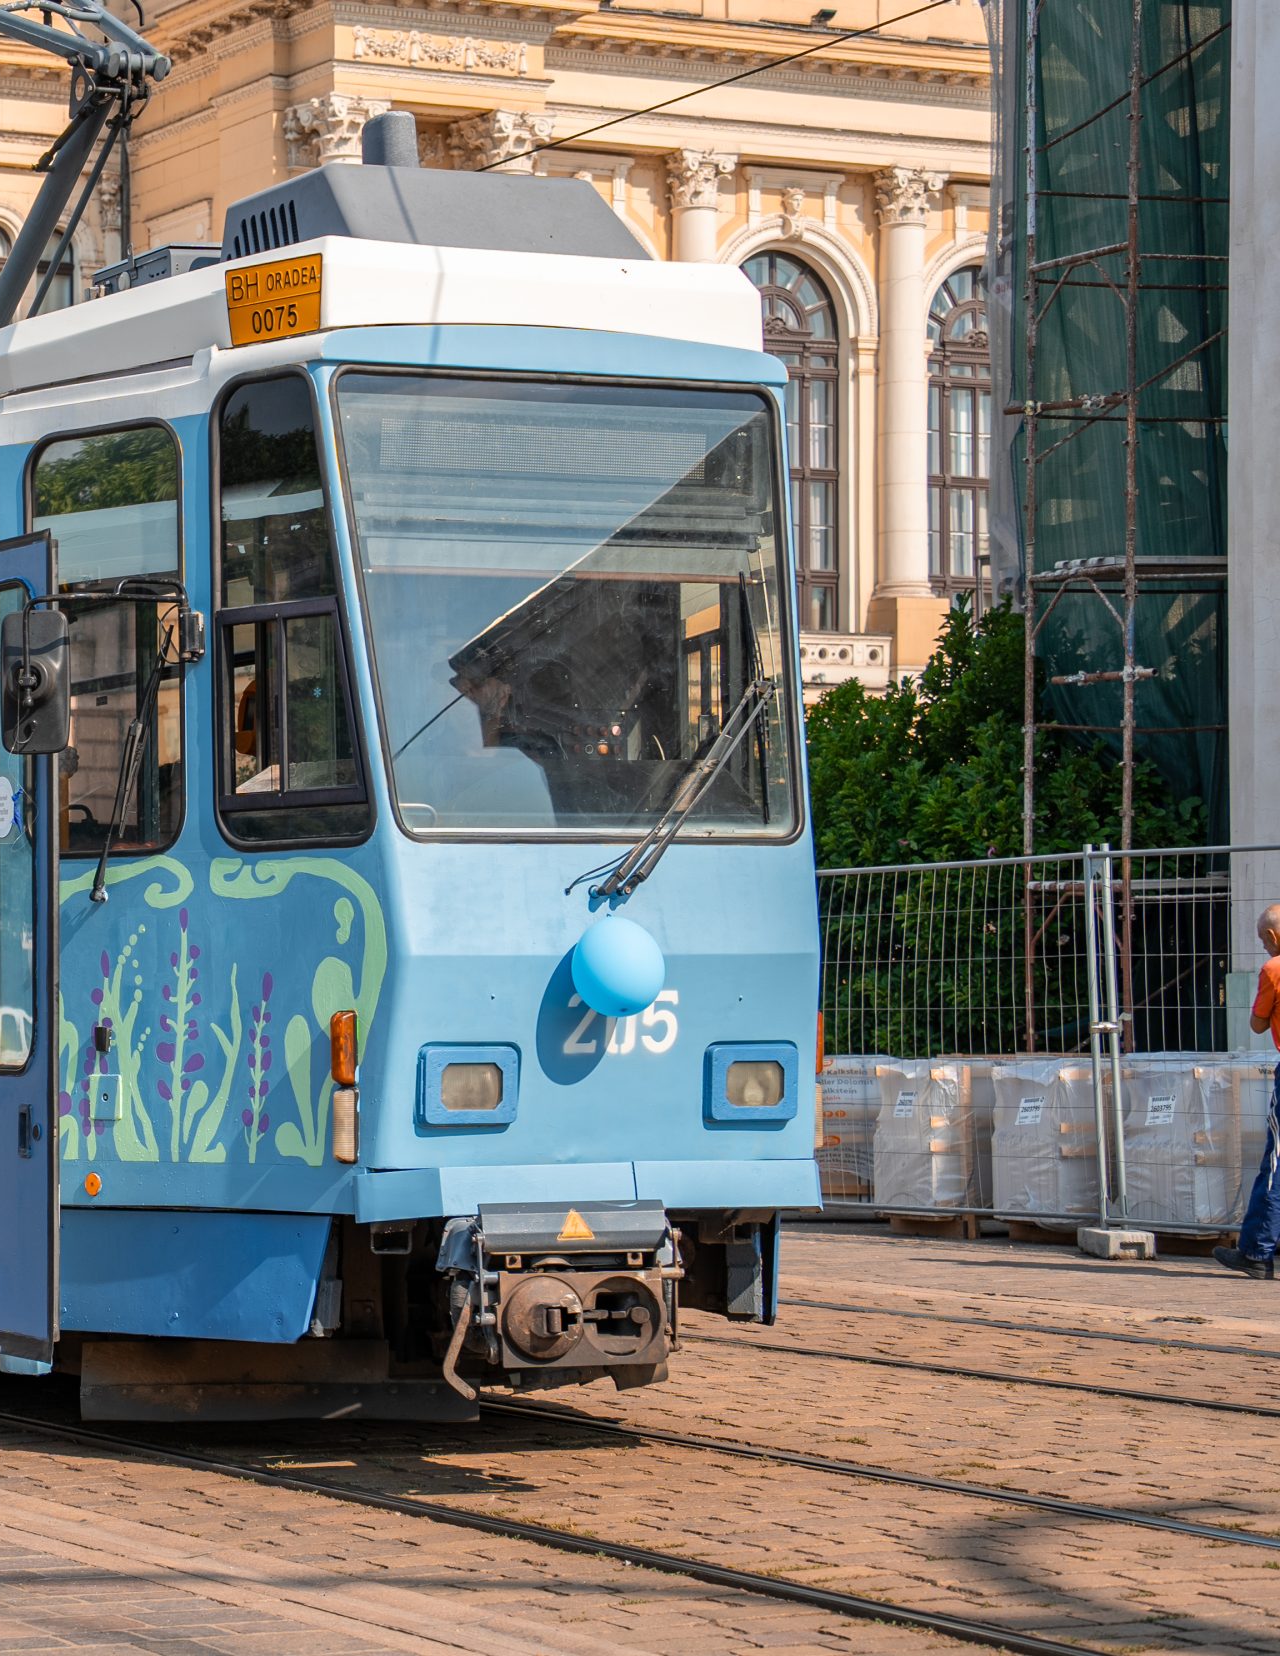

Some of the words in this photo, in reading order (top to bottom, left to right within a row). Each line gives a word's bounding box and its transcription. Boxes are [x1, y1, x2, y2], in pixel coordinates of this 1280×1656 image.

[231, 271, 260, 301] BH
[266, 265, 317, 291] ORADEA
[252, 304, 298, 334] 0075
